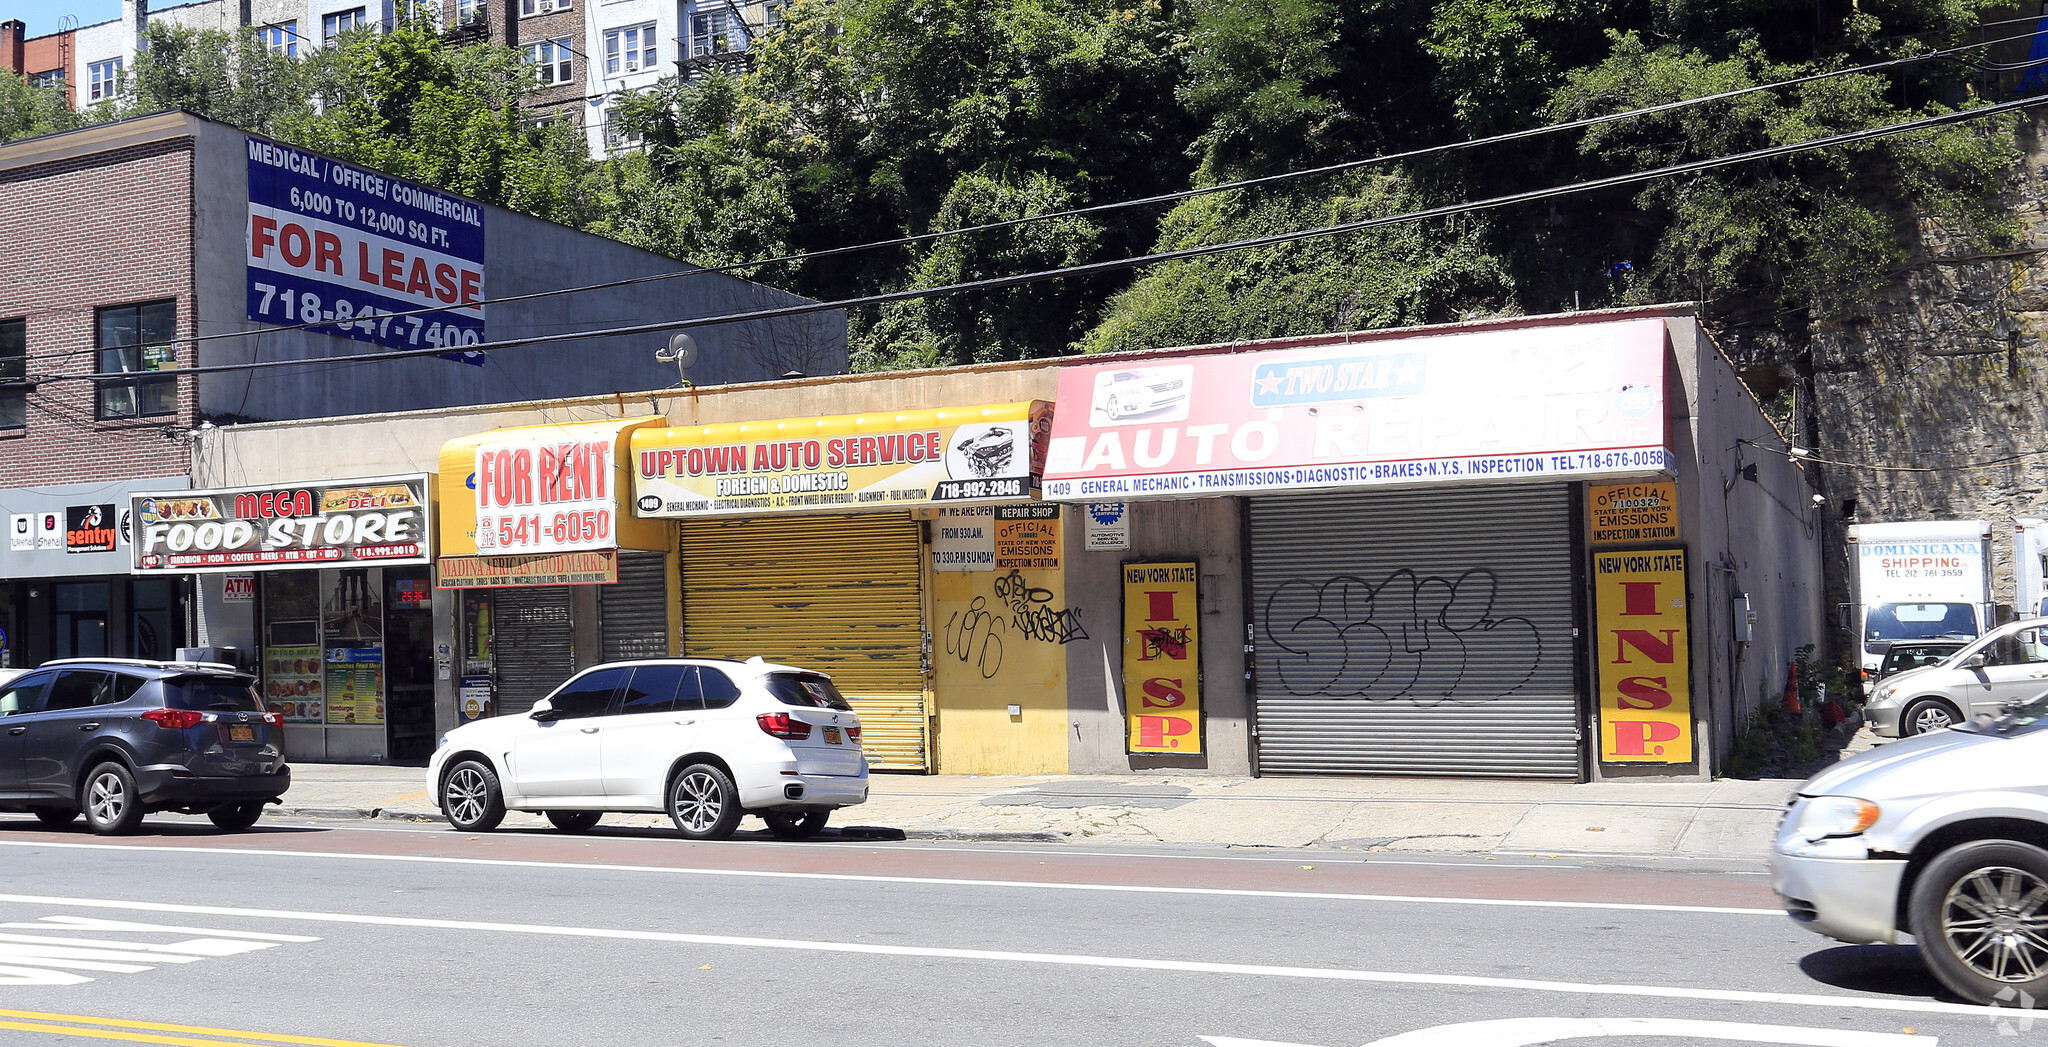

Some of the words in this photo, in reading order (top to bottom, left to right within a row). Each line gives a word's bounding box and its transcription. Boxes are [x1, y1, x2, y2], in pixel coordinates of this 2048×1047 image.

[248, 140, 320, 179] MEDICAL
[392, 182, 481, 227] COMMERCIAL
[290, 187, 332, 214] 6,000
[335, 198, 356, 221] TO
[360, 206, 405, 235] 12,000
[408, 222, 428, 243] SQ
[431, 227, 450, 248] FT.
[251, 214, 344, 276] FOR
[358, 240, 482, 311] LEASE
[254, 282, 480, 358] 718-847-7400
[1284, 364, 1334, 395] TWO
[1334, 359, 1393, 392] STAR
[640, 444, 748, 479] UPTOWN
[752, 439, 822, 473] AUTO
[827, 430, 941, 468] SERVICE
[1081, 420, 1281, 473] AUTO
[480, 448, 533, 508] FOR
[539, 440, 609, 504] RENT
[1047, 482, 1071, 496] 1409
[1081, 479, 1129, 494] GENERAL
[1133, 476, 1190, 492] MECHANIC
[1198, 470, 1290, 488] TRANSMISSIONS
[1296, 466, 1367, 483] DIAGNOSTIC
[1375, 463, 1422, 478] BRAKES
[1429, 460, 1464, 476] N.Y.S.
[1468, 457, 1544, 474] INSPECTION
[716, 477, 768, 497] FOREIGN
[770, 478, 780, 493] &
[782, 471, 848, 493] DOMESTIC
[940, 480, 1020, 499] 718-992-2846
[234, 490, 312, 520] MEGA
[348, 495, 387, 509] DELI
[640, 498, 659, 509] 1409
[667, 502, 686, 512] GENERAL
[686, 501, 709, 511] MECHANIC
[714, 499, 740, 510] ELECTRICAL
[740, 497, 771, 508] DIAGNOSTICS
[789, 495, 804, 506] FRONT
[804, 494, 820, 505] WHEEL
[820, 494, 834, 505] DRIVE
[834, 493, 854, 504] REBUILT
[858, 491, 886, 502] ALIGNMENT
[890, 490, 901, 501] FUEL
[902, 489, 927, 500] INJECTION
[1597, 486, 1669, 506] OFFICIAL
[1613, 498, 1660, 509] 7100329
[949, 508, 959, 516] WE
[961, 506, 975, 516] ARE
[976, 505, 993, 516] OPEN
[1001, 508, 1030, 518] REPAIR
[1032, 507, 1053, 517] SHOP
[1599, 513, 1668, 527] EMISSIONS
[143, 521, 253, 552] FOOD
[265, 510, 414, 548] STORE
[481, 531, 495, 547] 212
[499, 509, 610, 546] 541-6050
[941, 527, 958, 539] FROM
[1000, 522, 1055, 538] OFFICIAL
[1593, 528, 1640, 541] INSPECTION
[1642, 526, 1675, 538] STATION
[67, 527, 115, 550] sentry
[170, 555, 201, 565] SANDWICH
[207, 554, 225, 563] SODA
[230, 552, 255, 562] COFFEE
[260, 551, 279, 560] BEERS
[285, 550, 299, 559] ATM
[306, 549, 318, 559] EBT
[324, 548, 339, 558] WIC
[355, 544, 415, 557] 718.992.0018
[932, 551, 941, 563] TO
[966, 551, 995, 564] SUNDAY
[1001, 546, 1053, 556] EMISSIONS
[1860, 543, 1980, 557] DOMINICANA
[442, 558, 483, 577] MADINA
[485, 555, 532, 576] AFRICAN
[535, 554, 565, 574] FOOD
[566, 552, 611, 573] MARKET
[996, 558, 1032, 568] INSPECTION
[1033, 558, 1058, 568] STATION
[1599, 557, 1621, 574] NEW
[1623, 556, 1652, 573] YORK
[1654, 555, 1682, 572] STATE
[1882, 557, 1960, 568] SHIPPING
[1126, 569, 1146, 583] NEW
[1147, 568, 1170, 583] YORK
[1171, 567, 1195, 583] STATE
[1904, 569, 1917, 577] 212
[1924, 569, 1963, 577] 781-3859
[225, 579, 255, 593] ATM
